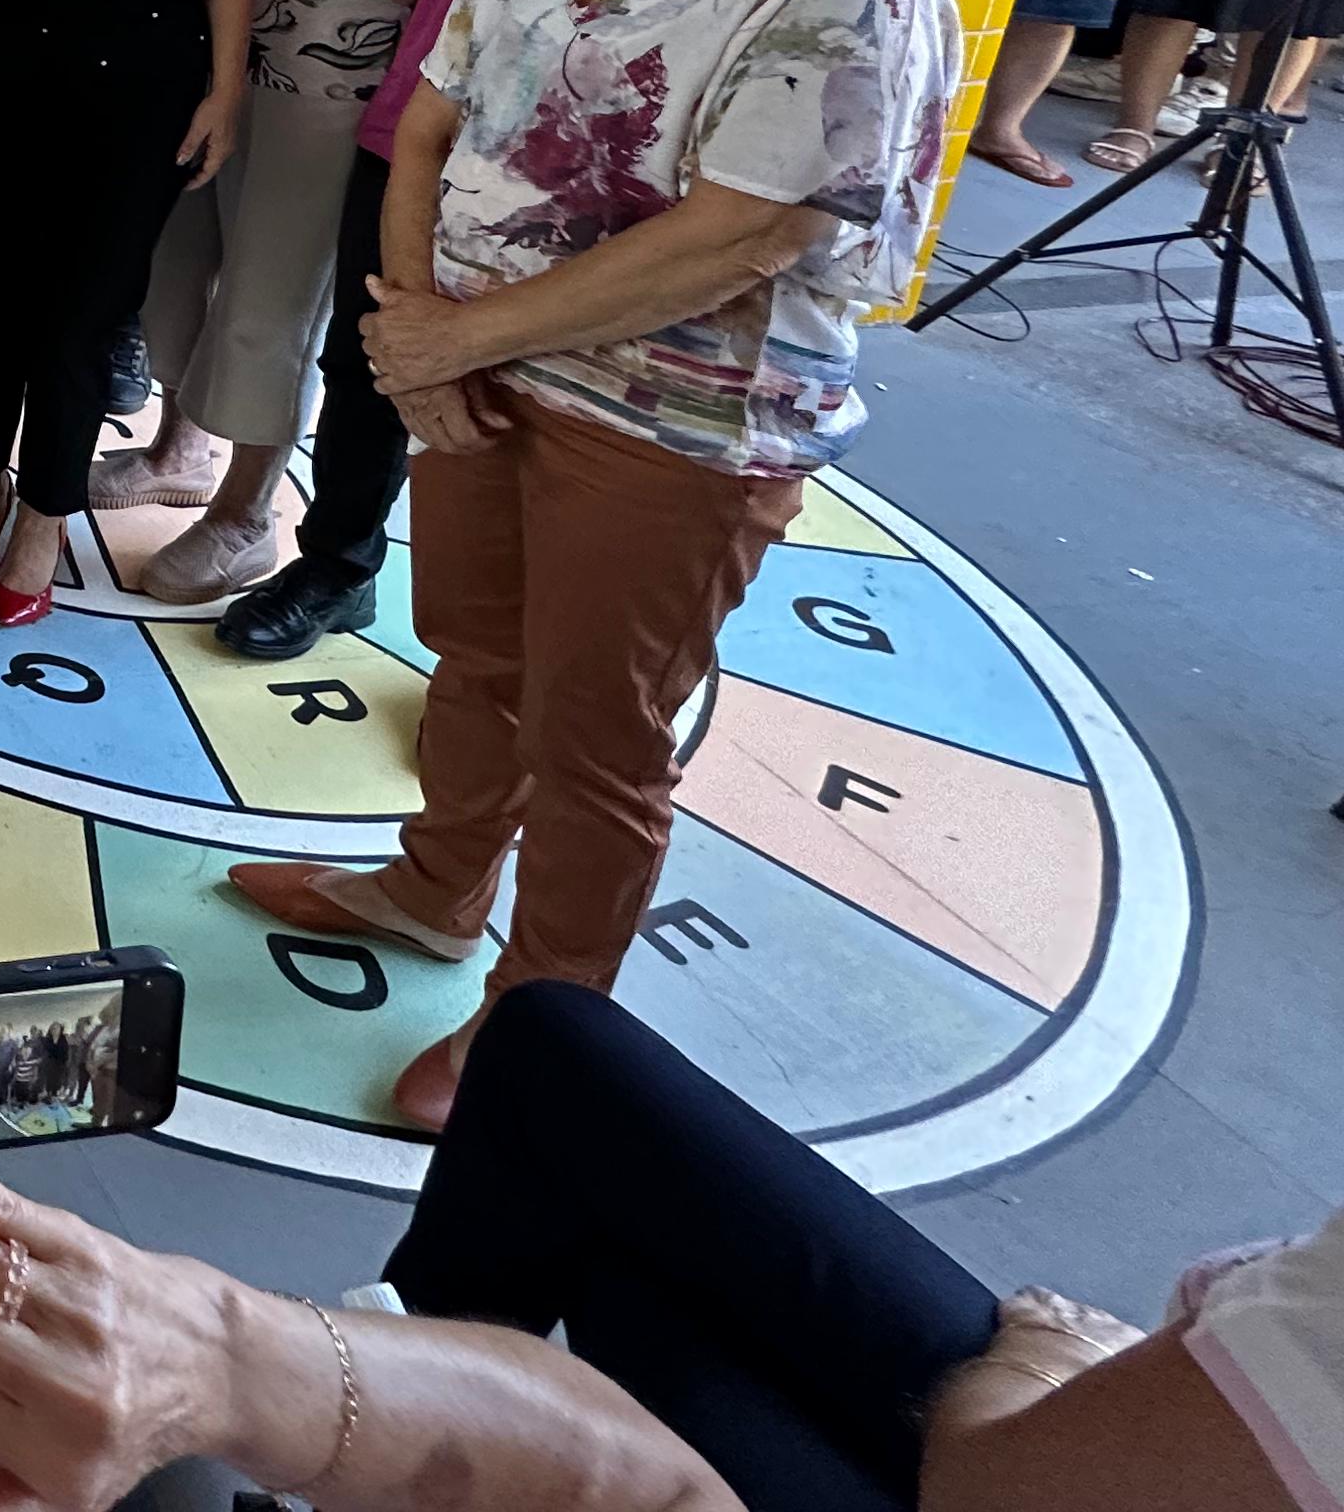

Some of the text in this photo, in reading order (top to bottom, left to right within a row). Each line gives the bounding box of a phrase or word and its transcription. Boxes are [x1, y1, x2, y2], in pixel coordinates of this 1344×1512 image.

[791, 596, 897, 656] G
[0, 652, 107, 705] Q
[266, 679, 369, 727] R
[817, 763, 903, 815] F
[634, 897, 750, 966] E
[266, 932, 390, 1013] D
